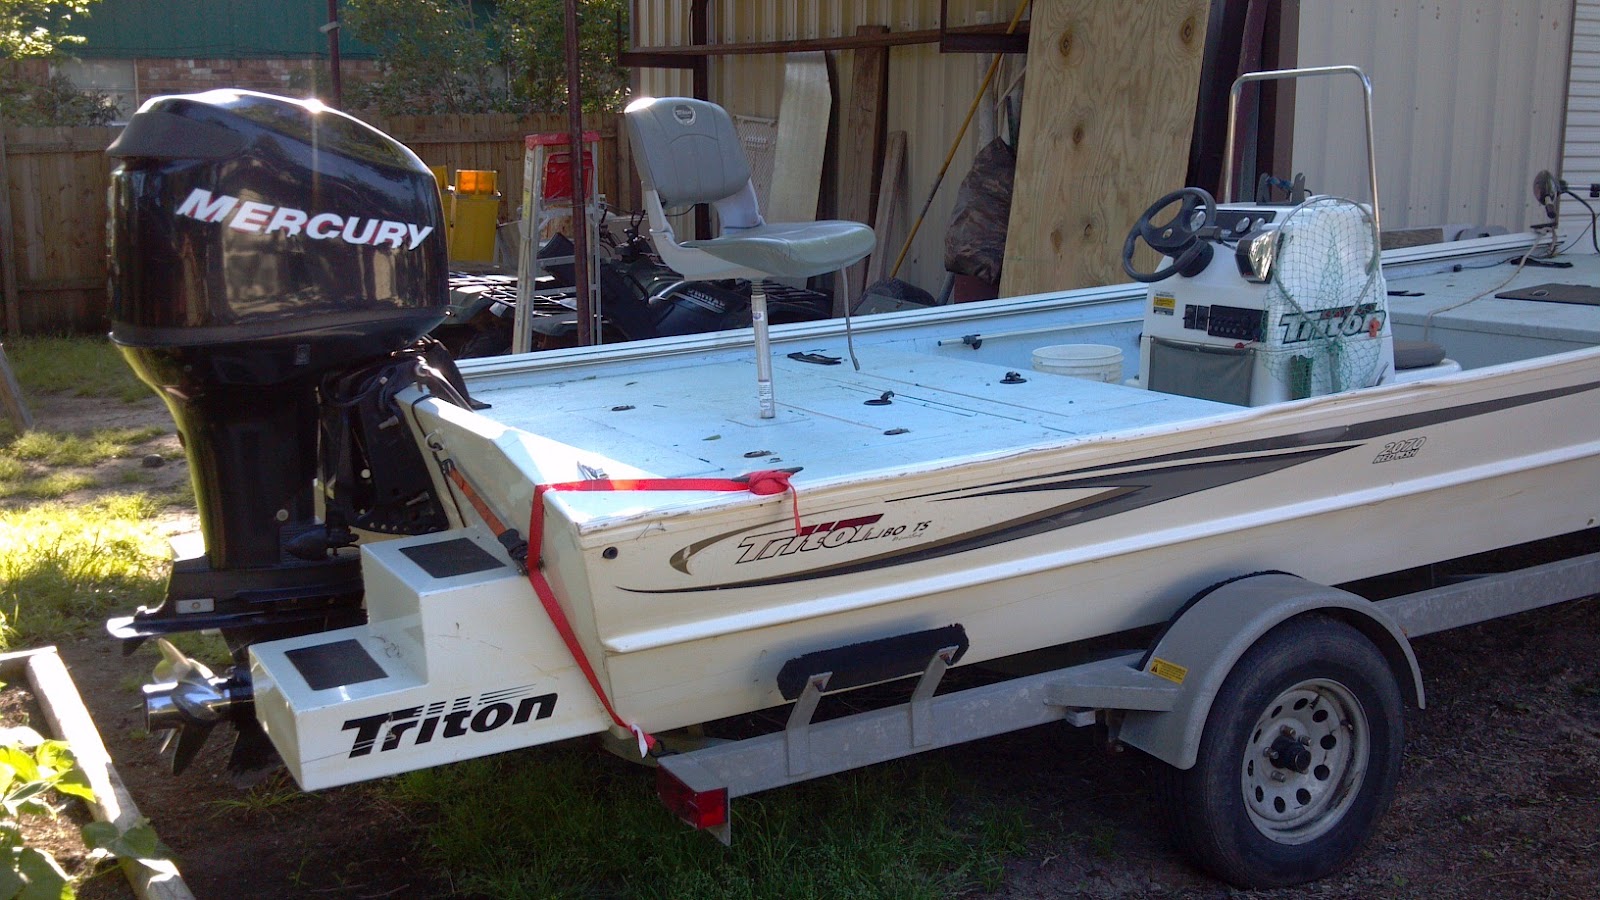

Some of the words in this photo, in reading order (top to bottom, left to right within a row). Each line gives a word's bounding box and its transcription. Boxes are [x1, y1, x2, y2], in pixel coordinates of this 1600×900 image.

[176, 187, 433, 250] MERCURY
[1372, 448, 1420, 464] REDSH
[1378, 436, 1427, 456] 2070
[881, 520, 932, 538] BOTS
[341, 685, 558, 759] Triton
